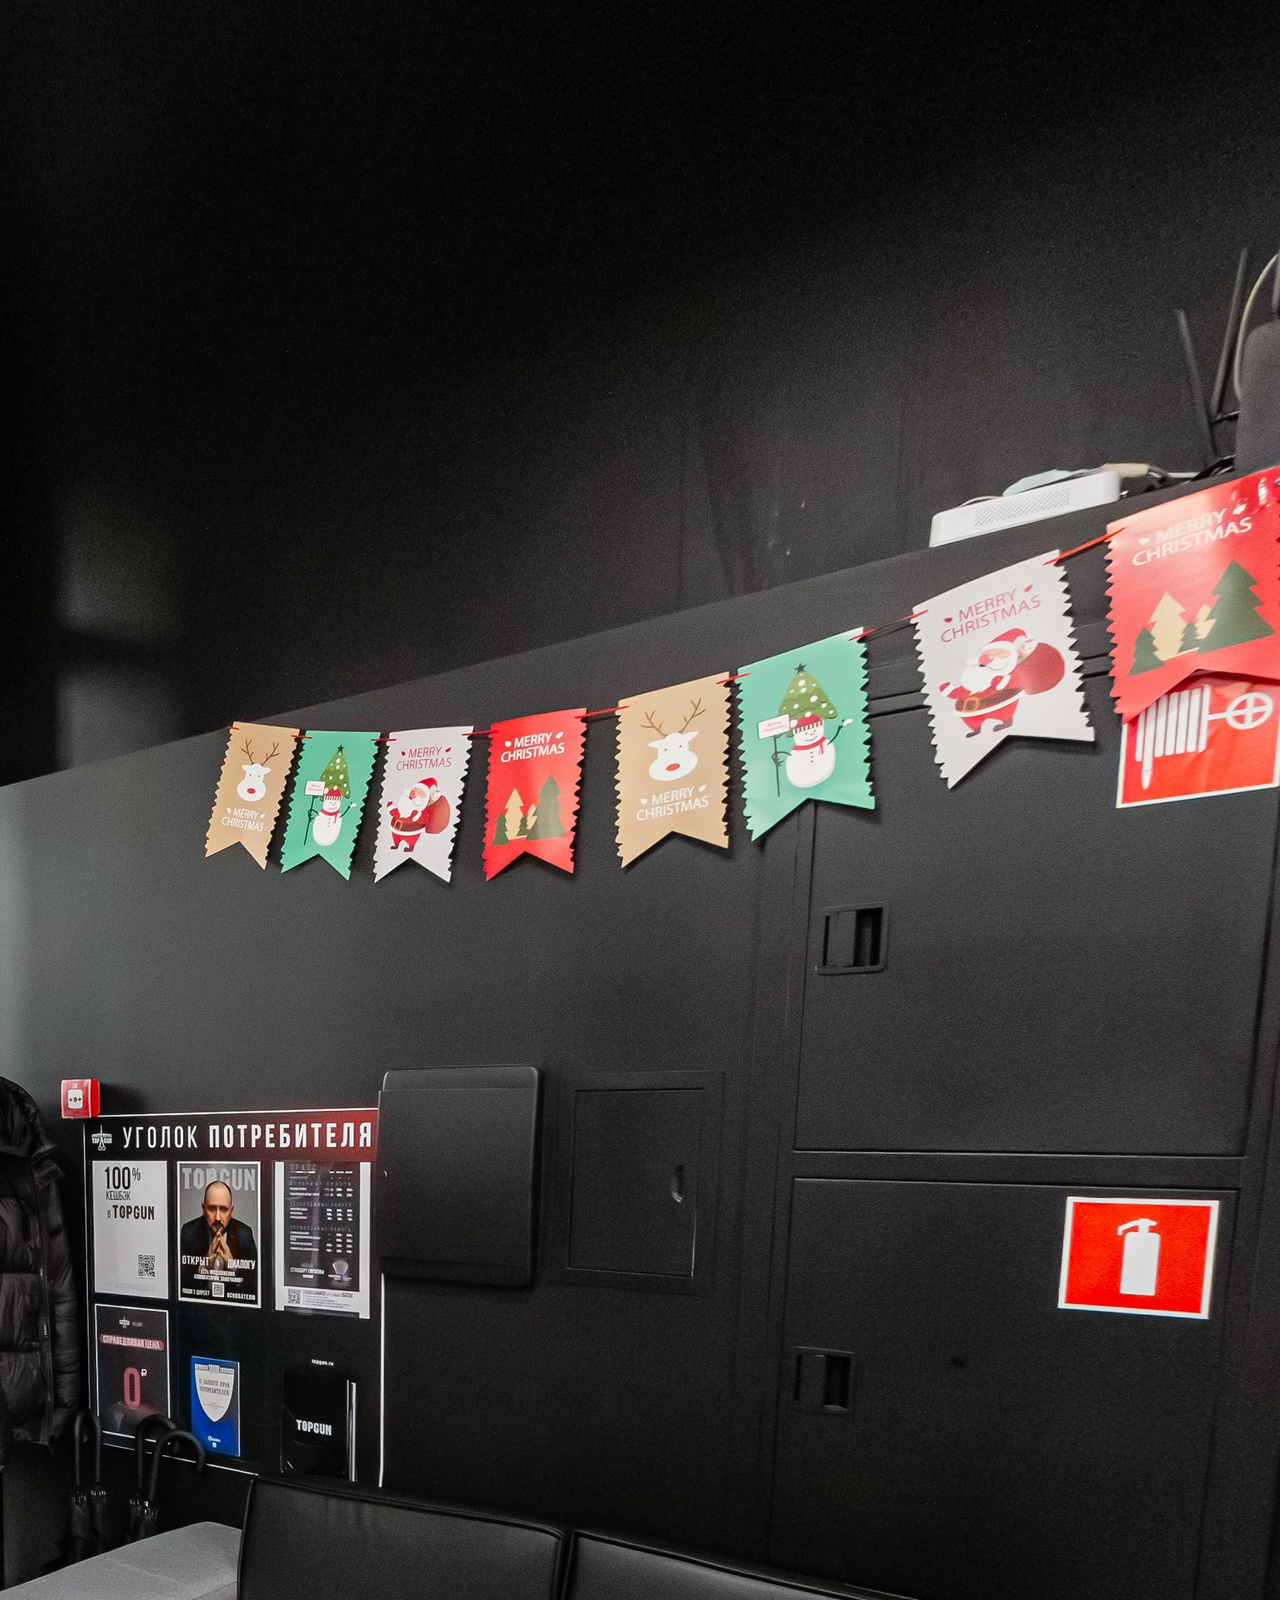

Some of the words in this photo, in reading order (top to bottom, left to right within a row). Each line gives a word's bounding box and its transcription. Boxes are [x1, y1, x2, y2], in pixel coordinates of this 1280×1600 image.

[1155, 508, 1227, 543] MERRY
[1132, 517, 1252, 566] CHRISTMAS
[957, 588, 1018, 622] MERRY
[941, 595, 1042, 644] CHRISTMAS
[513, 731, 553, 749] MERRY
[407, 746, 442, 759] MERRY
[500, 742, 565, 763] CHRISTMAS
[395, 757, 453, 770] CHRISTMAS
[651, 784, 696, 806] MERRY
[232, 807, 260, 820] MERRY
[636, 795, 710, 821] CHRISTMAS
[221, 817, 265, 832] CHRISTMAS
[123, 1125, 198, 1148] УГОЛОК
[209, 1122, 372, 1149] ПОТРЕБИТЕЛЯ
[182, 1167, 256, 1191] TOPGUN
[112, 1205, 155, 1220] TOPGUN
[182, 1255, 210, 1266] ОТКРЫТ
[296, 1419, 332, 1436] TOPGUN
